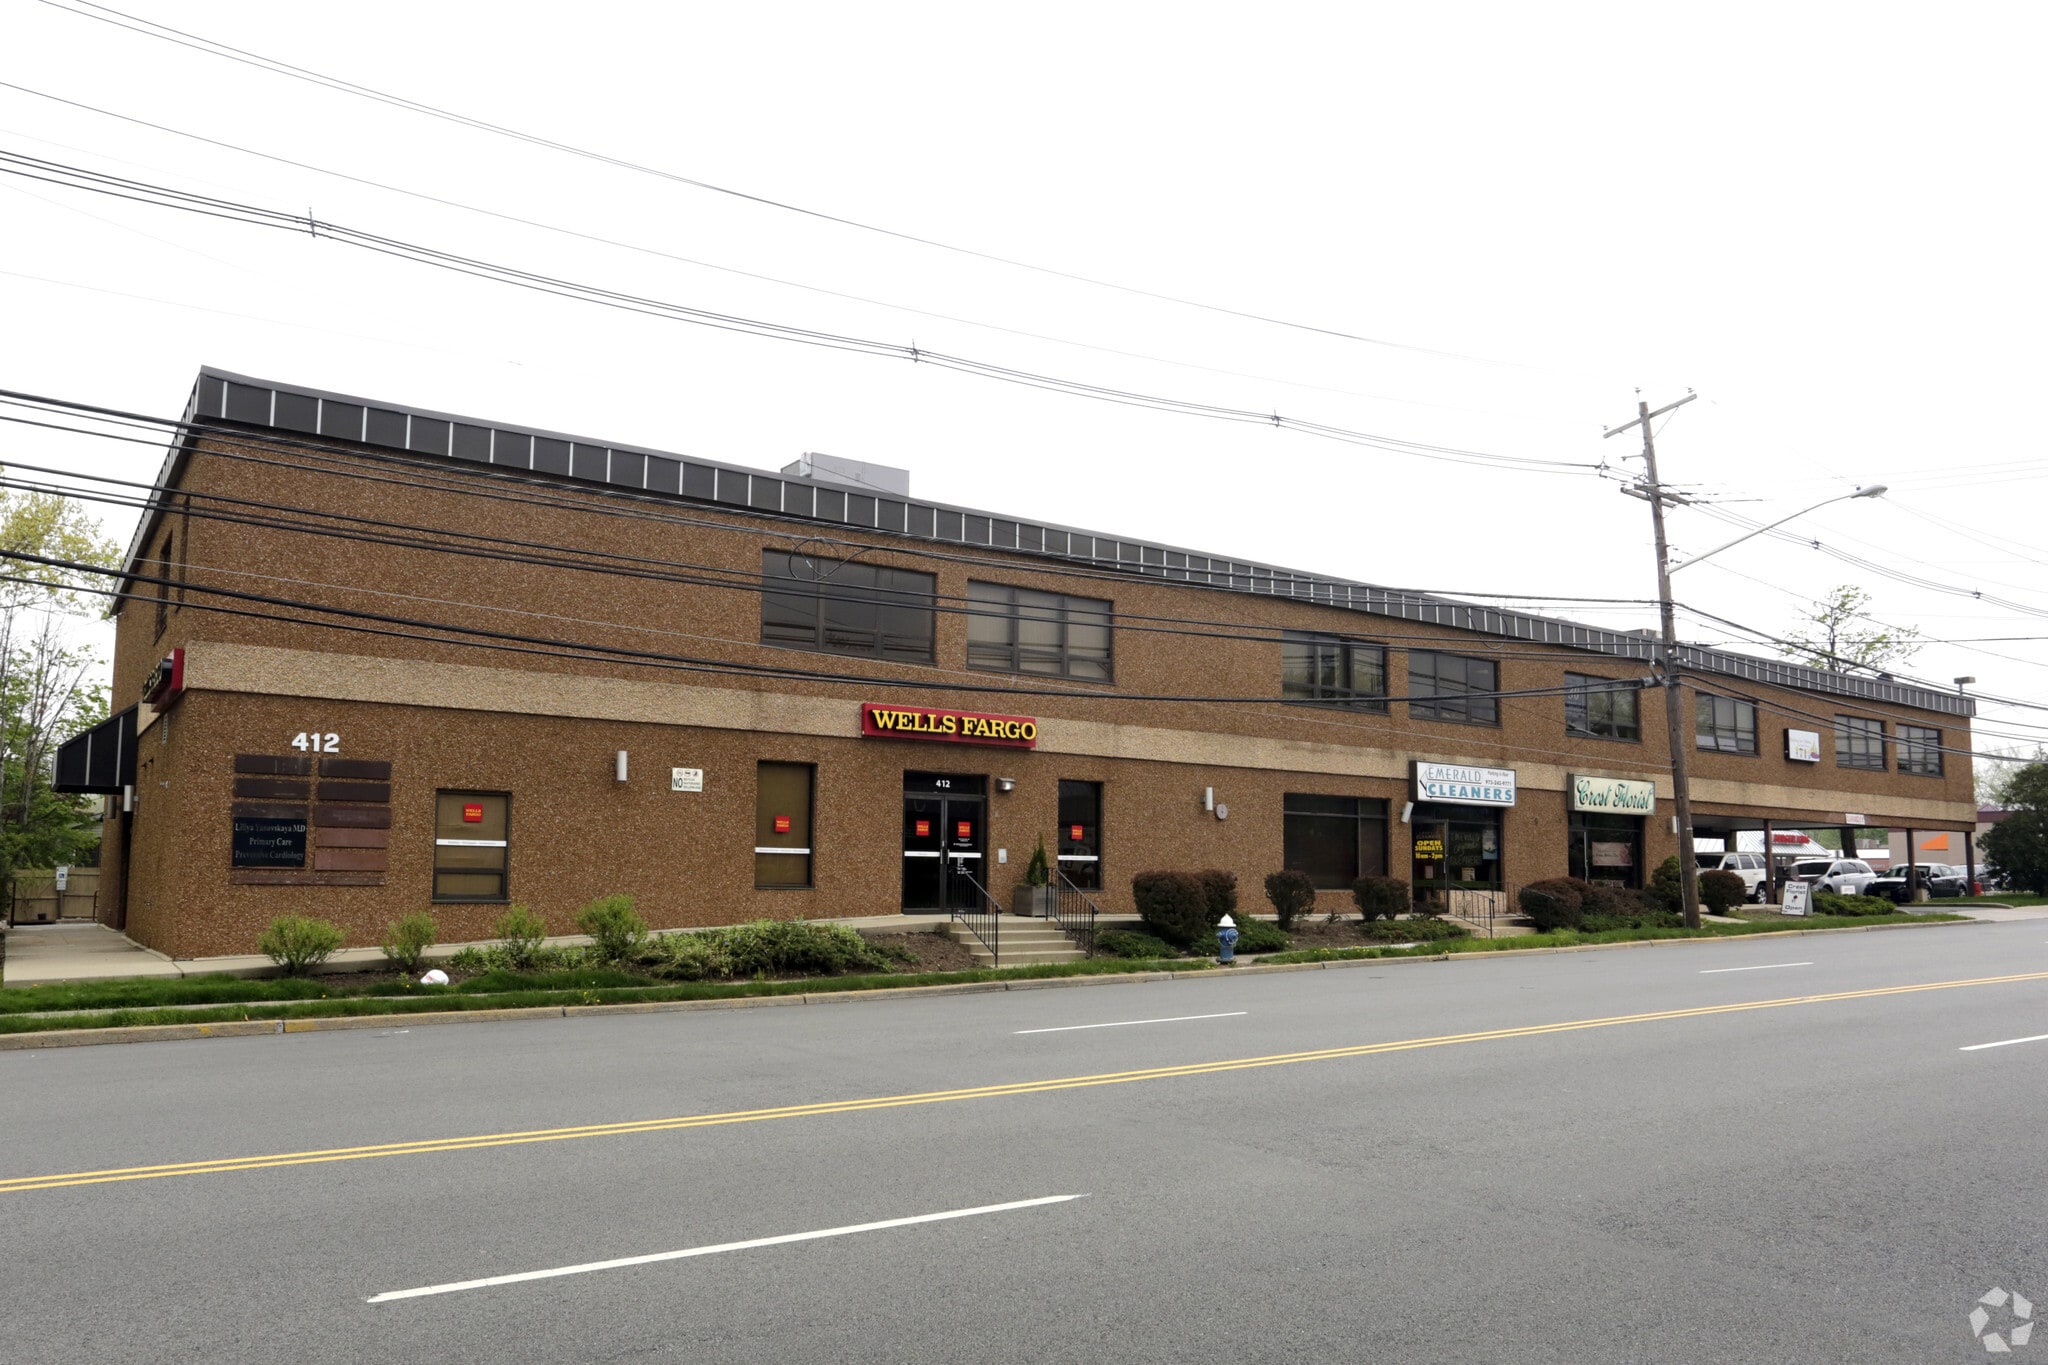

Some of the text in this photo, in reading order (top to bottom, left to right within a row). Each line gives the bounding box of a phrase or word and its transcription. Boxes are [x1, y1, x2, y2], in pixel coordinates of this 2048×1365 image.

[872, 709, 1037, 740] WELLS FARGO
[291, 732, 340, 753] 412
[1428, 767, 1481, 782] EMERALD
[672, 777, 684, 789] NO
[935, 779, 951, 788] 412
[1427, 783, 1513, 801] CLEANERS
[1576, 780, 1652, 810] Crest Florist
[249, 837, 293, 848] Primary Care
[269, 850, 304, 861] Cardiology
